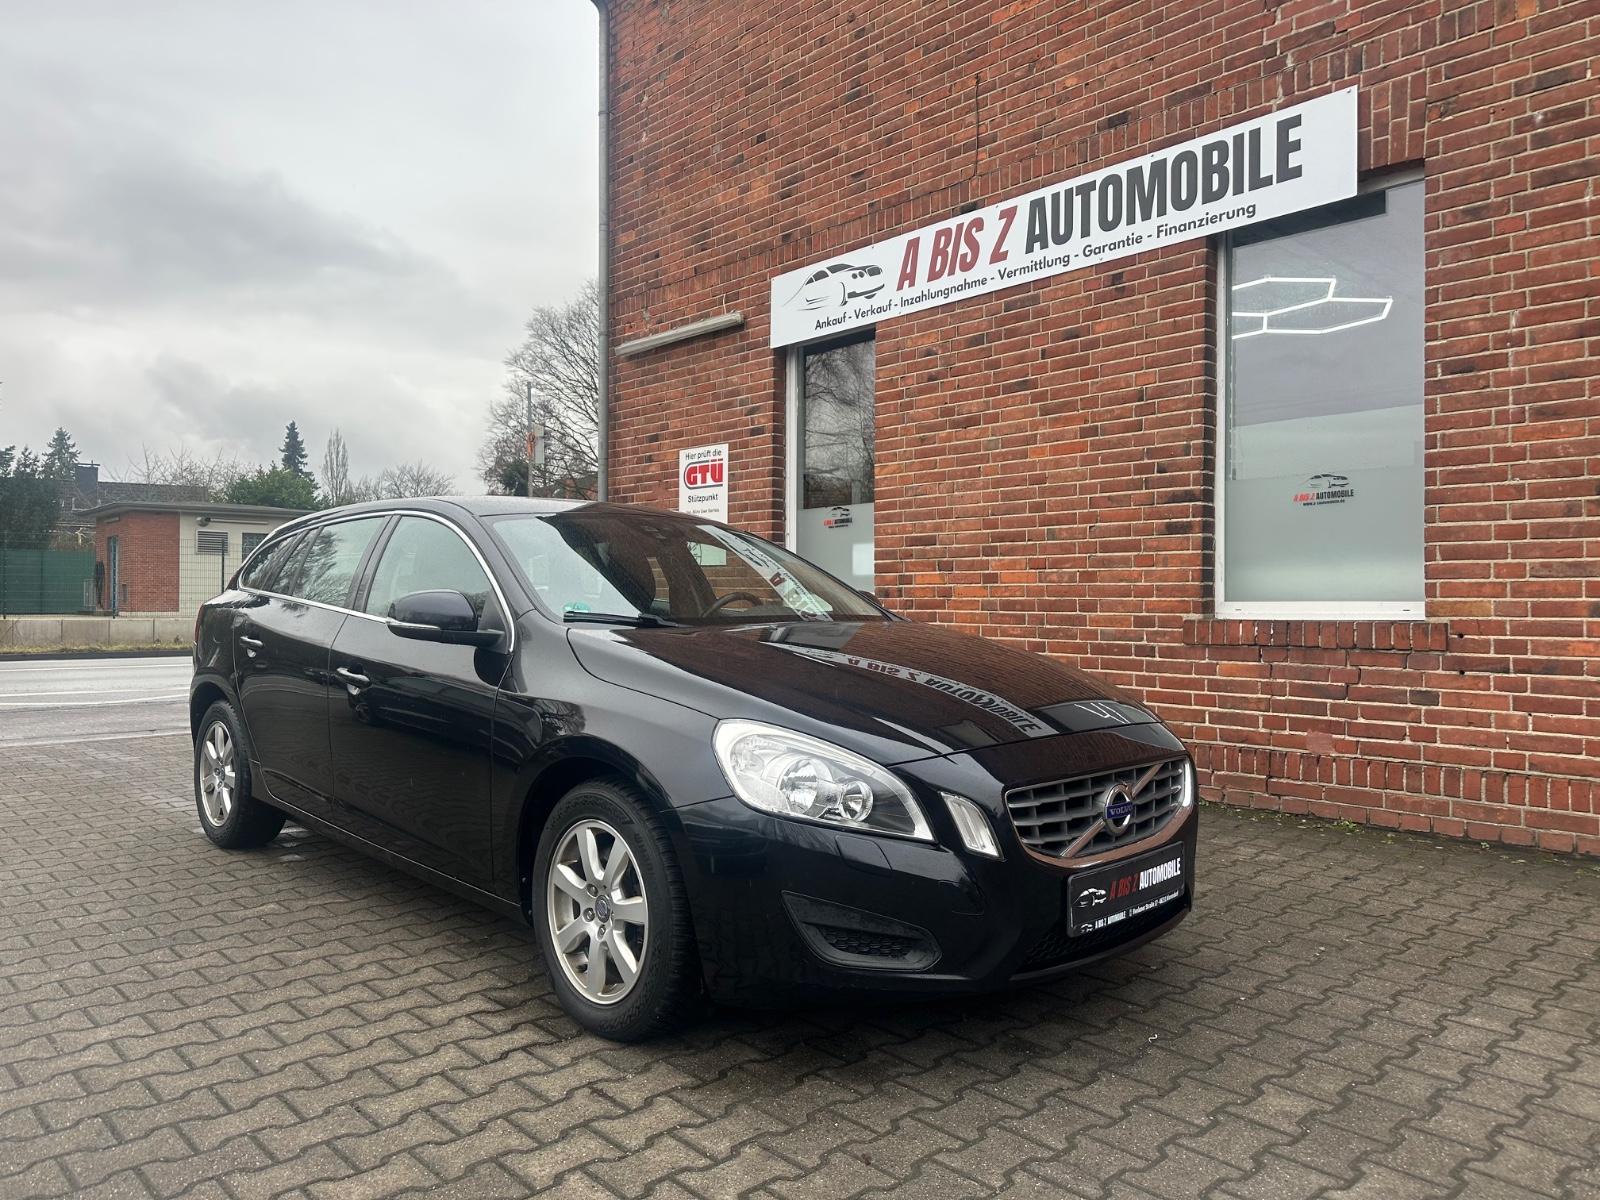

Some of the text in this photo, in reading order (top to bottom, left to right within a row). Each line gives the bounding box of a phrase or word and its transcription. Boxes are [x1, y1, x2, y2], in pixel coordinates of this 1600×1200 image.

[896, 113, 1303, 291] A BIS Z AUTOMOBILE
[815, 312, 847, 330] Ankauf
[854, 300, 892, 320] Verkauf
[900, 277, 987, 308] Inzahlungnahme
[998, 253, 1070, 281] Vermittlung
[1082, 233, 1143, 258] Garantie
[1156, 203, 1257, 239] Finanzierung
[686, 449, 722, 460] Hier prüft die
[686, 458, 723, 486] GTÜ
[688, 493, 718, 503] Stützpunkt
[1316, 489, 1354, 500] AUTOMOBILE
[1110, 804, 1134, 815] VOLVO
[1139, 858, 1181, 890] AUTOMOBILE
